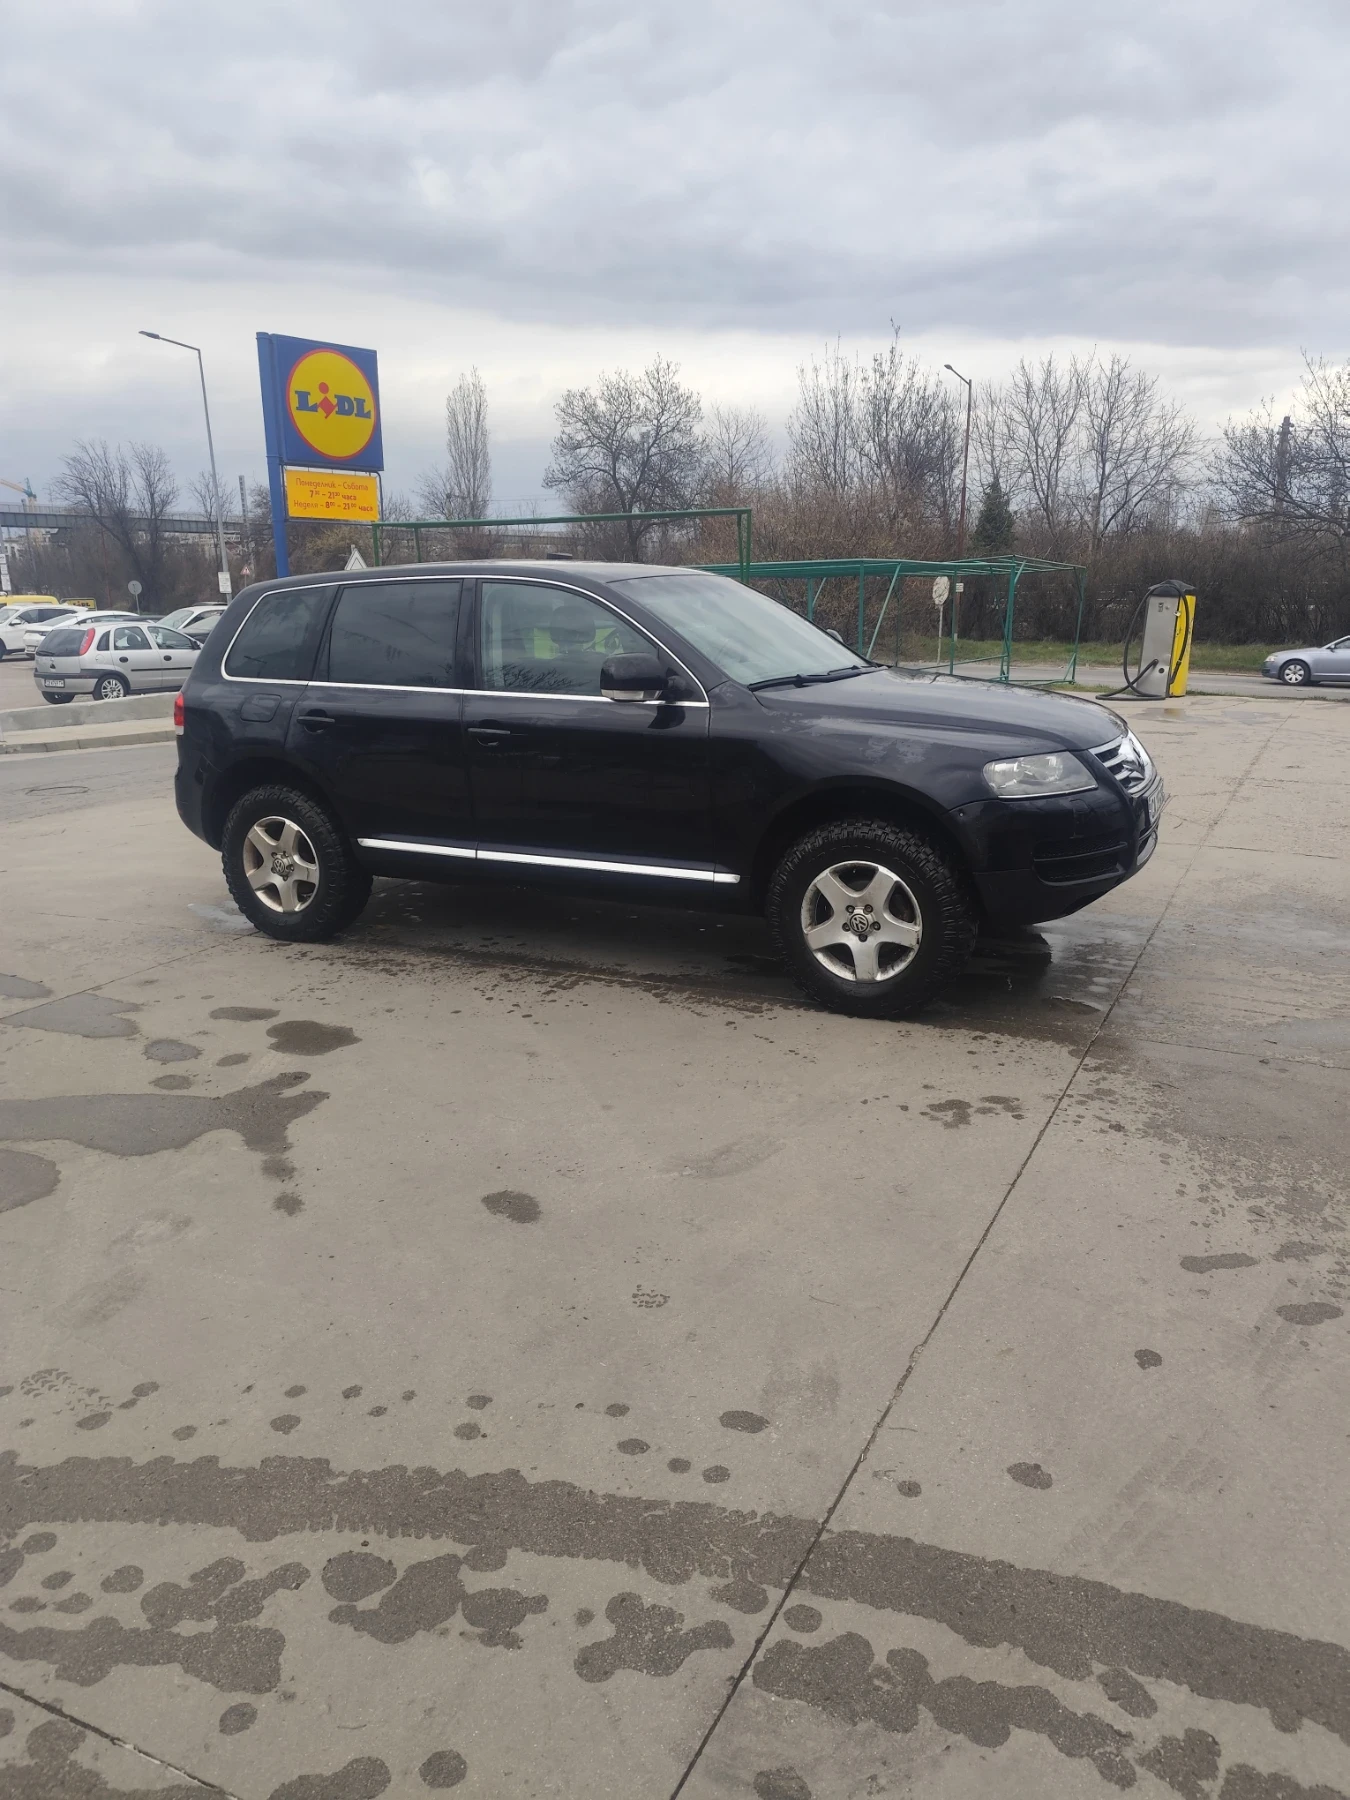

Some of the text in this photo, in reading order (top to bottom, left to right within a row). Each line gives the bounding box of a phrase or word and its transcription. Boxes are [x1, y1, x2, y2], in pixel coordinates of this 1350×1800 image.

[296, 478, 336, 489] Понеделник
[342, 482, 369, 491] Събота
[294, 500, 319, 510] Неделя
